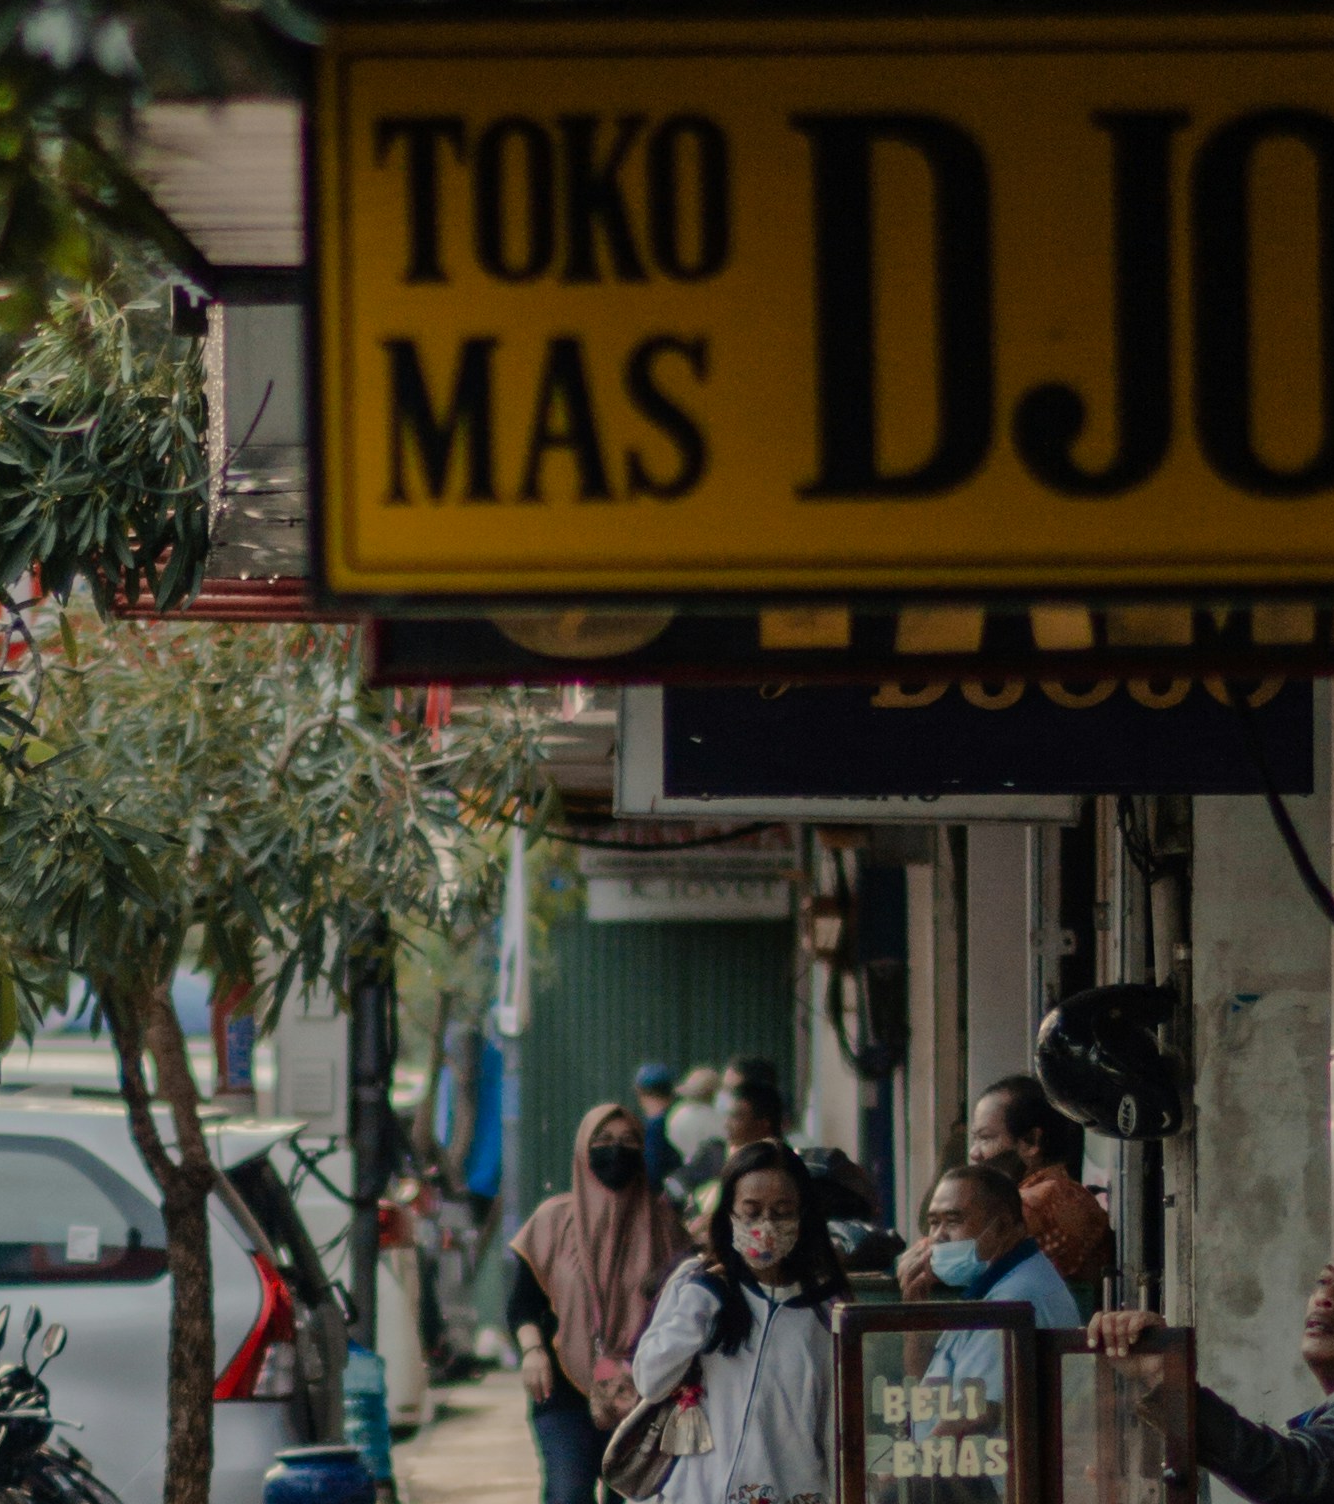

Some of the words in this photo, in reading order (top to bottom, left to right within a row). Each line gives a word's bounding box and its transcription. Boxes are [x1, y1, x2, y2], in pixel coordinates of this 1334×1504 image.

[374, 113, 731, 283] TOKO
[381, 334, 710, 503] MAS
[882, 1384, 979, 1424] BELI
[892, 1438, 1008, 1477] EMAS
